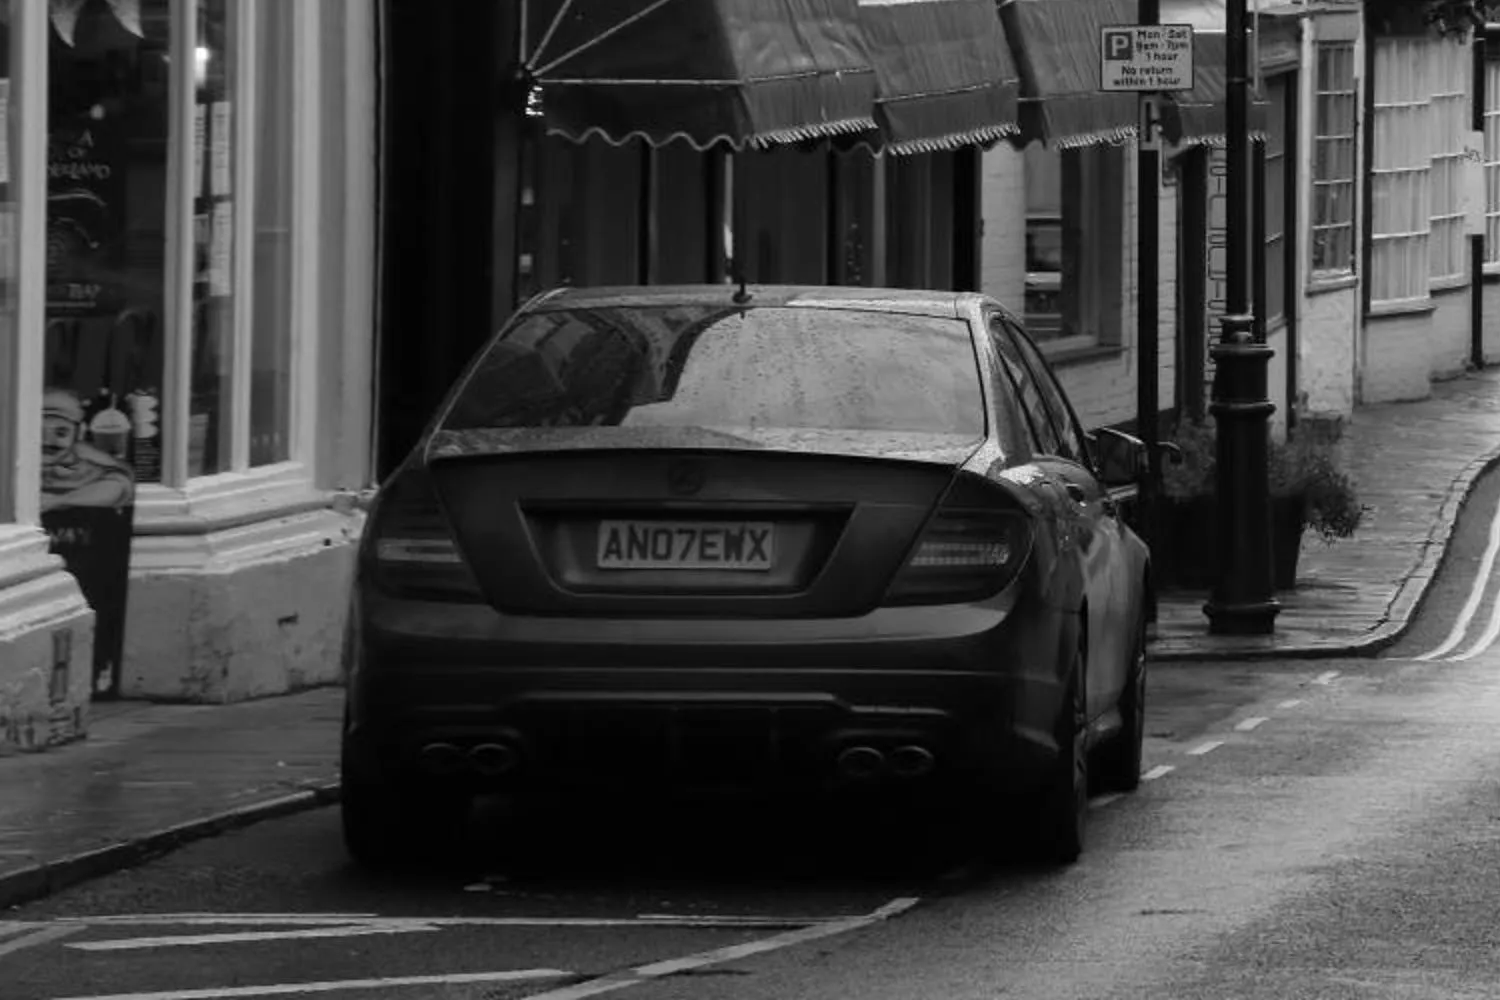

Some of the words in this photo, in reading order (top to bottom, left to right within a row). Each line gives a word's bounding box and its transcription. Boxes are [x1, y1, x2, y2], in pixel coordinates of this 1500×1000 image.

[1137, 30, 1160, 39] Mon
[1168, 29, 1188, 39] Sat
[1111, 35, 1129, 57] P
[1153, 52, 1179, 61] hour
[1121, 65, 1136, 75] No
[1139, 66, 1173, 75] return
[1113, 76, 1146, 86] within
[1157, 76, 1181, 86] hour
[602, 523, 769, 562] AN07EWX
